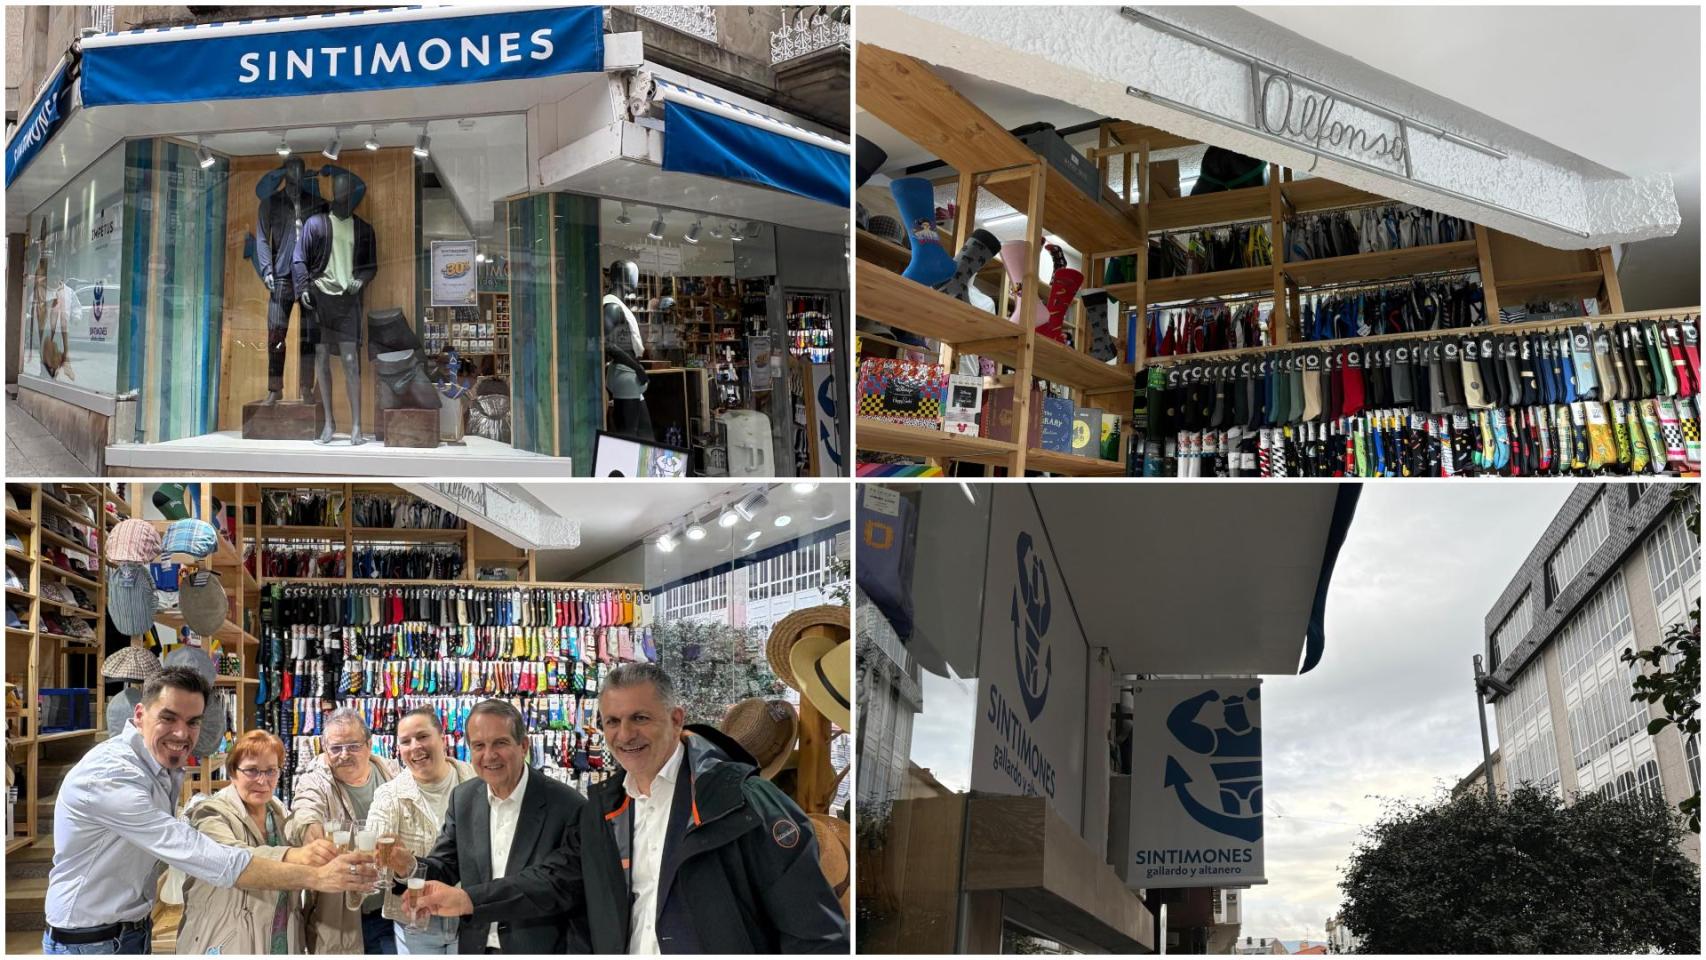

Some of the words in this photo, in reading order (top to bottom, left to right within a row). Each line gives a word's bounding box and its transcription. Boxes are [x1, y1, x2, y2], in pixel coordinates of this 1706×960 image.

[238, 28, 555, 84] SINTIMONES
[987, 683, 1056, 799] SINTIMONES
[993, 744, 1021, 788] gallardo
[1136, 848, 1252, 865] SINTIMONES
[1146, 865, 1188, 879] gallardo
[1191, 867, 1196, 877] y
[1199, 864, 1241, 875] altanero
